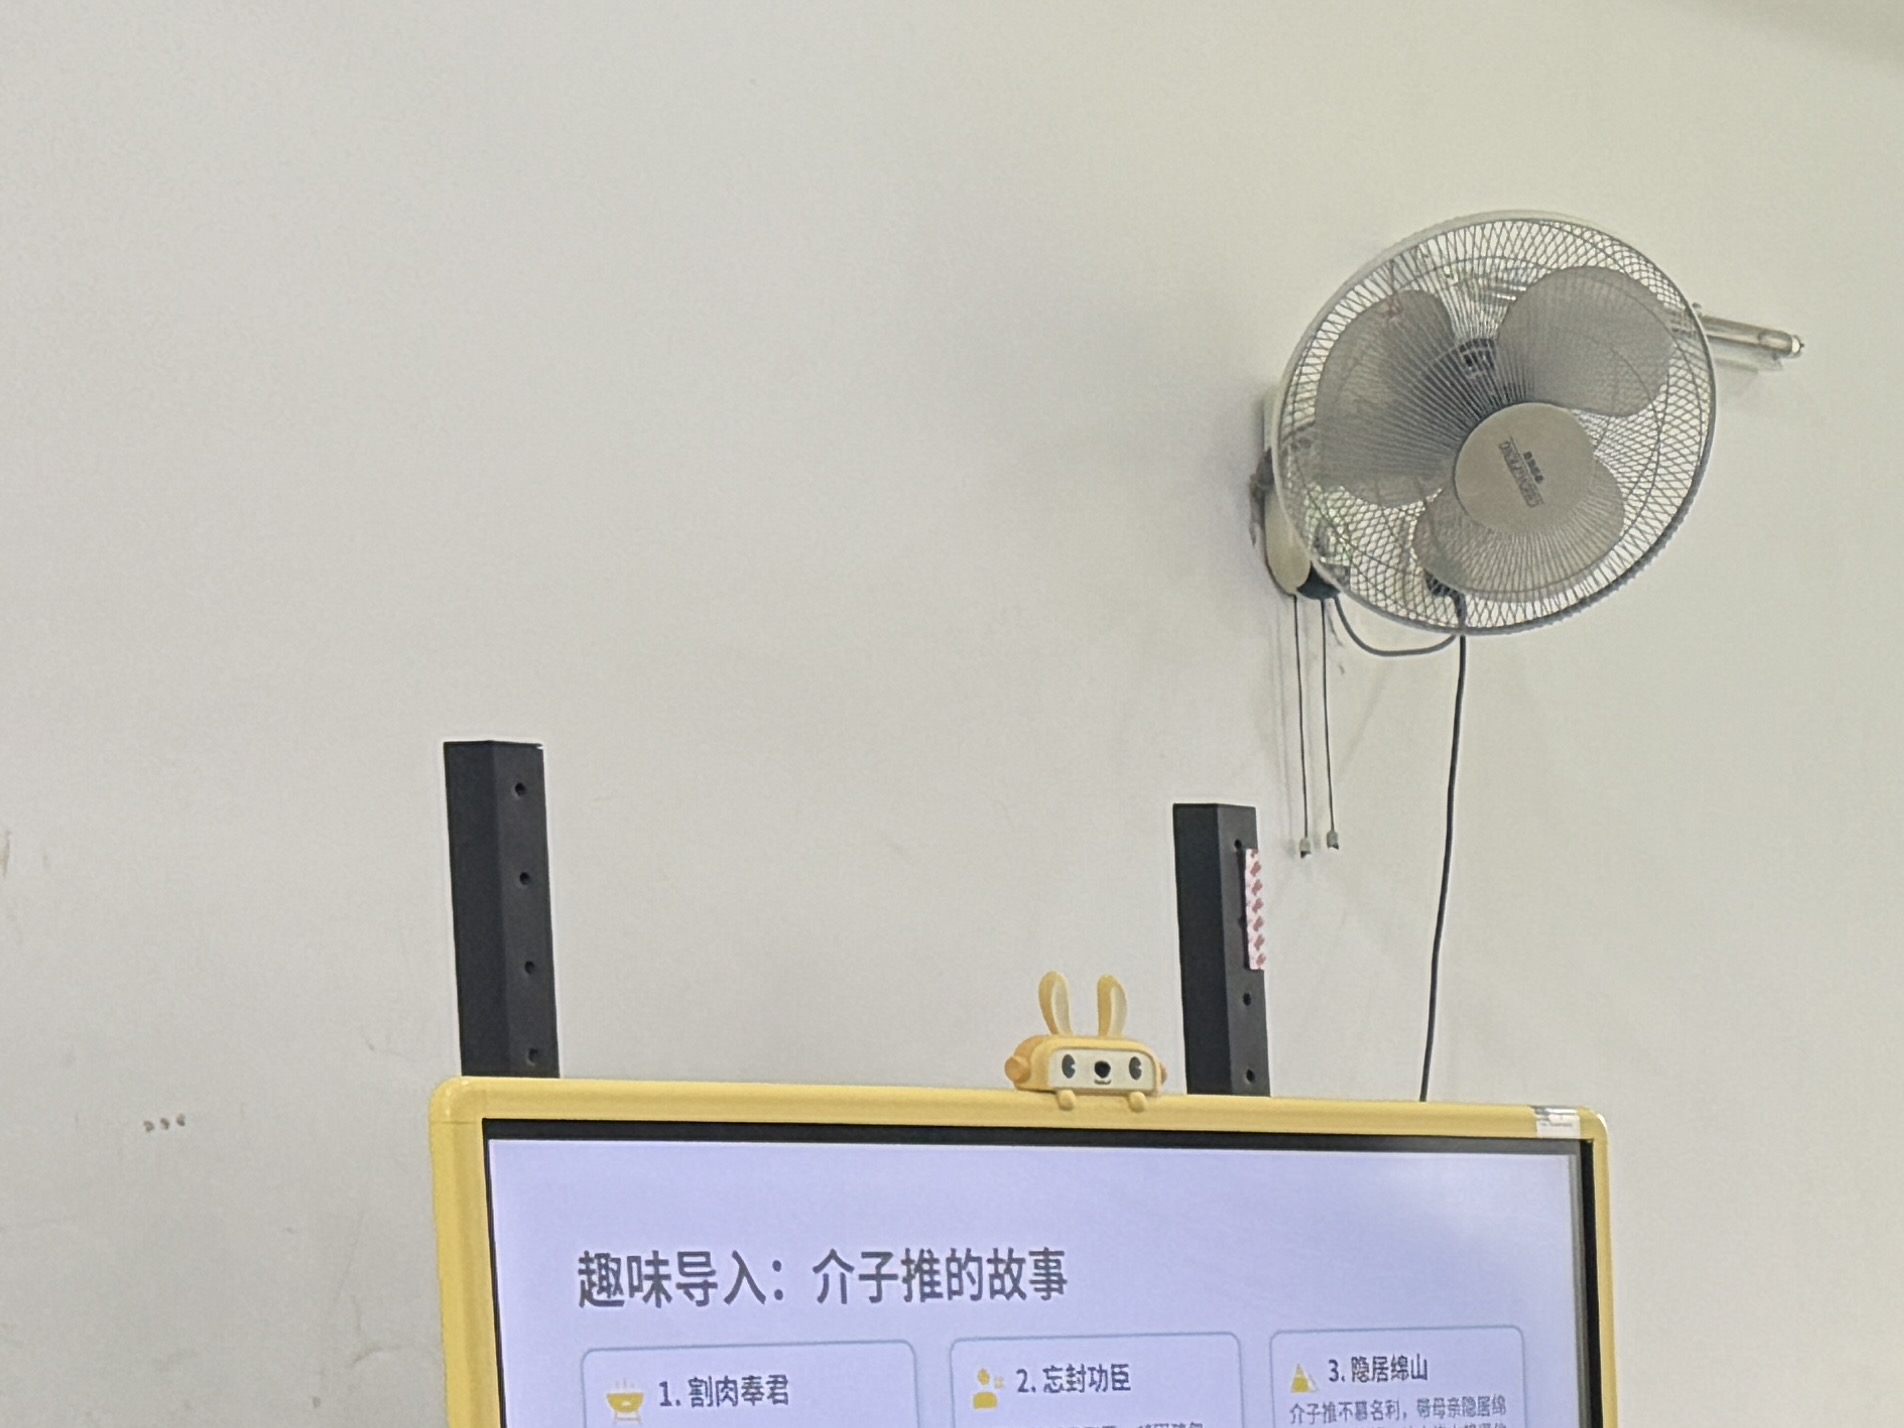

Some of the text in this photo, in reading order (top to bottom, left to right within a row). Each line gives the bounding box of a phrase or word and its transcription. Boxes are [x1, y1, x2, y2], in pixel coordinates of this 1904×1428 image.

[578, 1246, 1068, 1309] 趣味导入：介子推的故事
[1015, 1362, 1132, 1394] 2. 忘封功臣
[1327, 1352, 1429, 1384] 3. 隐居绵山
[658, 1373, 790, 1408] 1. 割肉奉君
